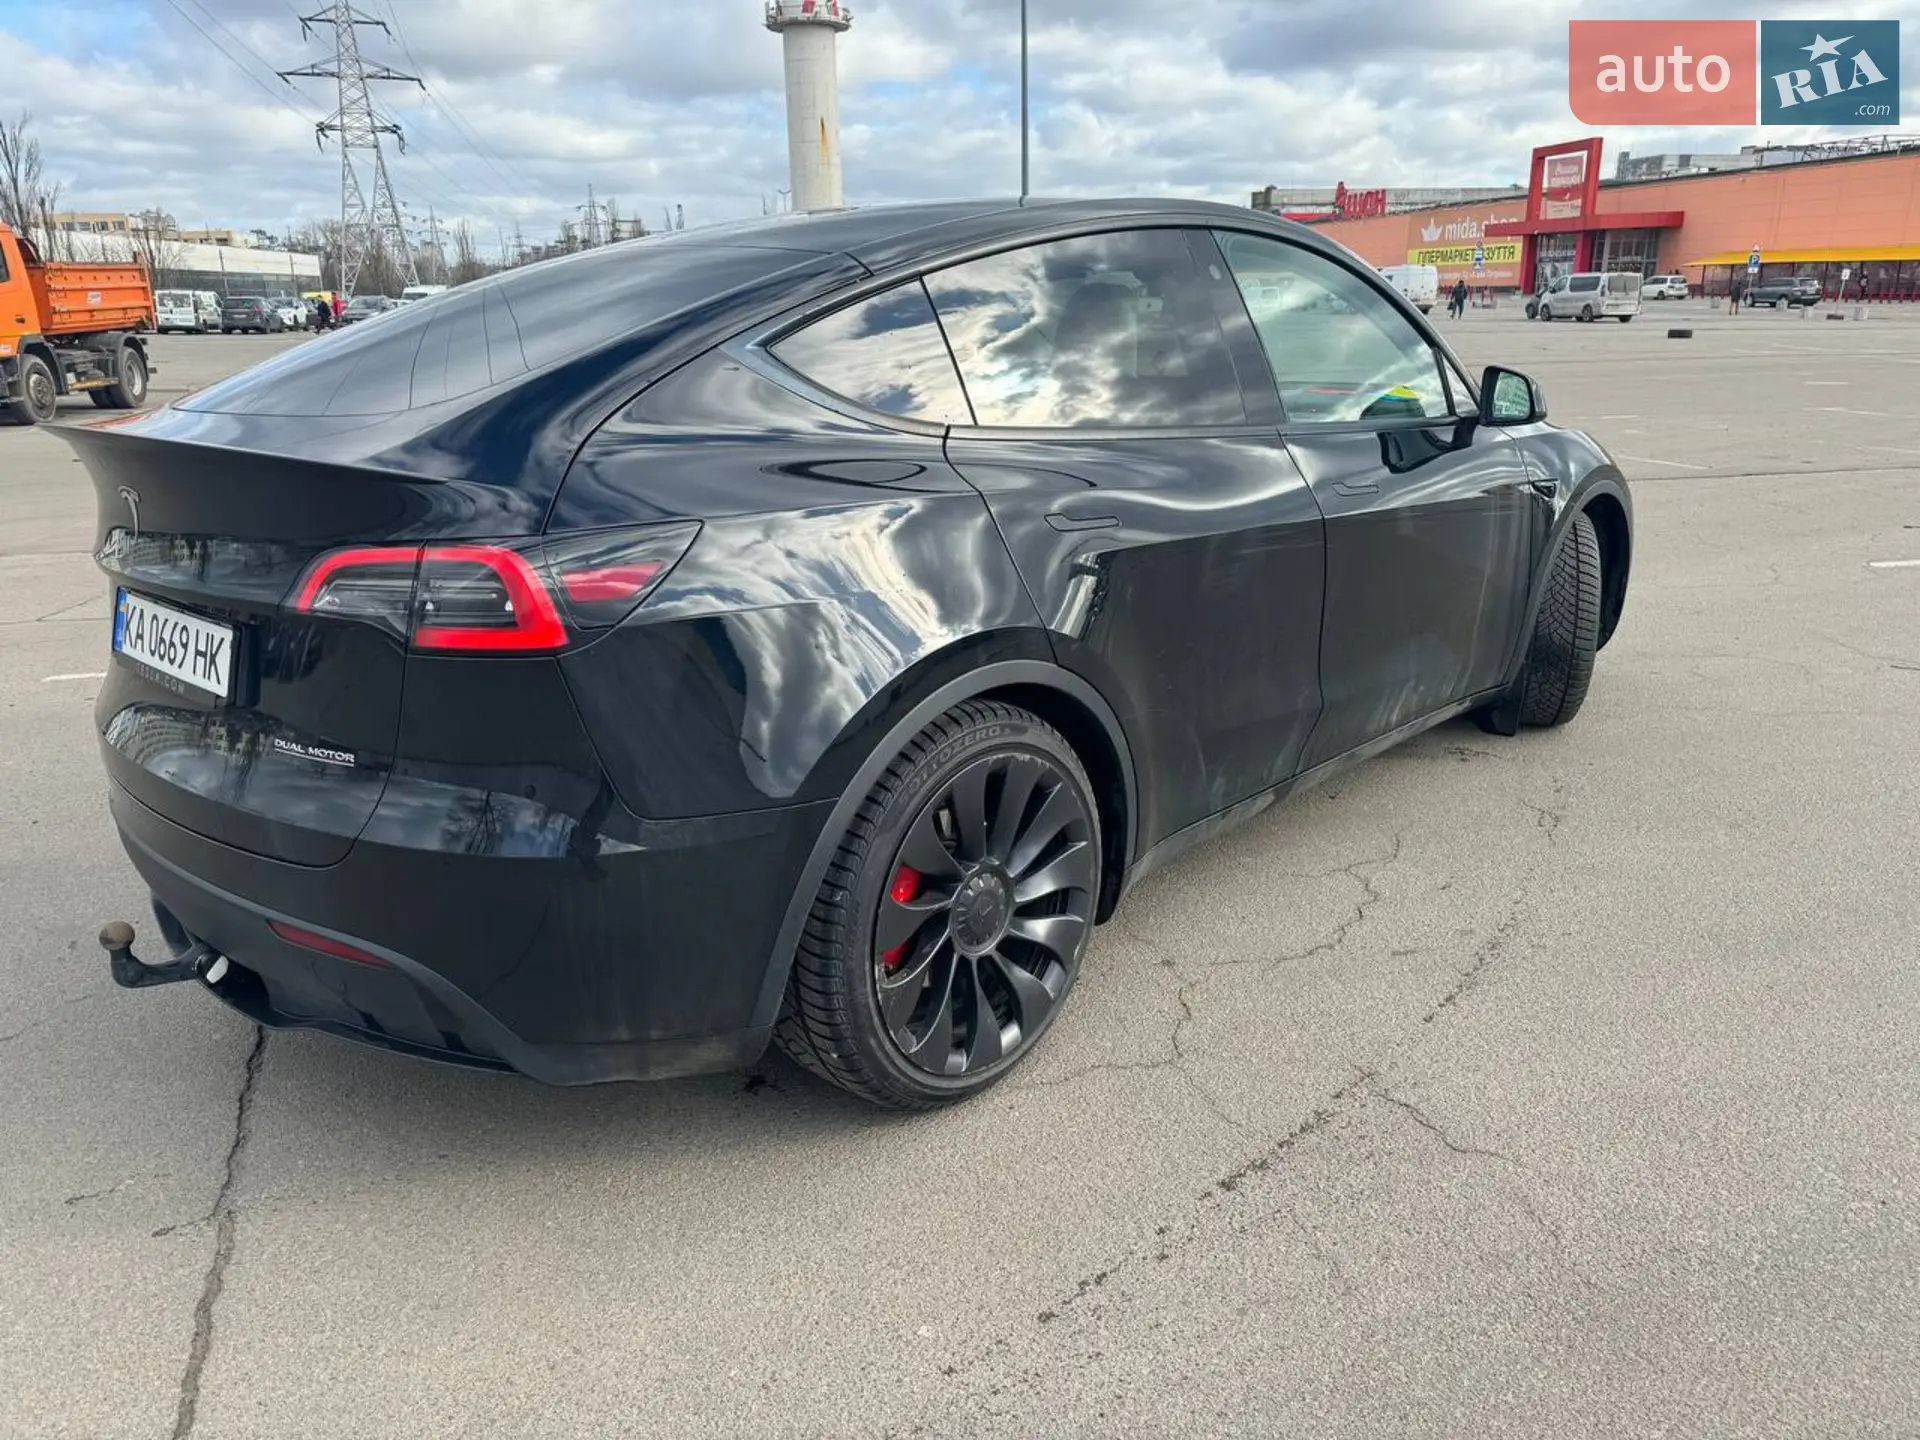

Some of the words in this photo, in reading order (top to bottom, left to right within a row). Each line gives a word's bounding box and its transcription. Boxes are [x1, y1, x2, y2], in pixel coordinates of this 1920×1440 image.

[1444, 213, 1519, 241] mida.sh
[1417, 248, 1476, 264] ГІПЕРМАРКЕТ
[124, 602, 145, 654] KA
[149, 612, 190, 670] 0669
[193, 629, 225, 685] HK
[274, 738, 306, 754] DUAL
[307, 746, 355, 763] MOTOR
